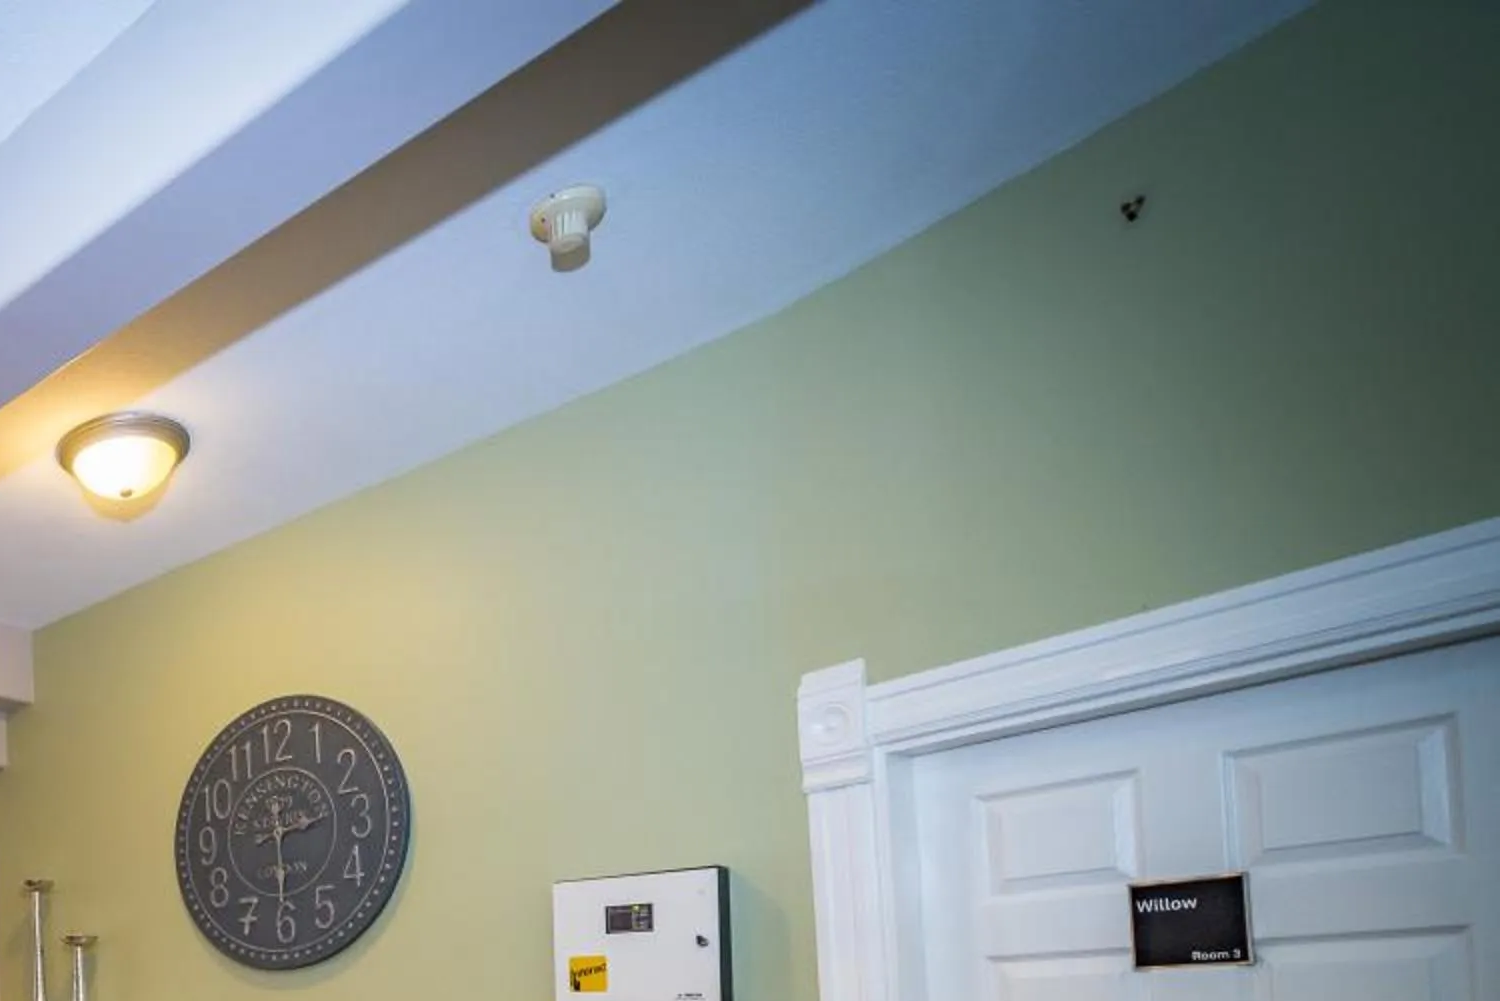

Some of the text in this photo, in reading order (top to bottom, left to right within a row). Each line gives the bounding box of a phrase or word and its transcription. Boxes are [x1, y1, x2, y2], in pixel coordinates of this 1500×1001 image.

[229, 741, 252, 781] 11
[260, 719, 293, 764] 12
[309, 723, 322, 764] 1
[337, 749, 359, 795] 2
[204, 778, 232, 821] 10
[351, 793, 372, 838] 3
[199, 826, 217, 866] 9
[343, 845, 365, 887] 4
[210, 867, 230, 908] 8
[315, 885, 335, 928] 5
[1136, 897, 1198, 913] Willow
[238, 897, 258, 936] 7
[276, 901, 296, 943] 6
[1191, 948, 1242, 961] Room 3
